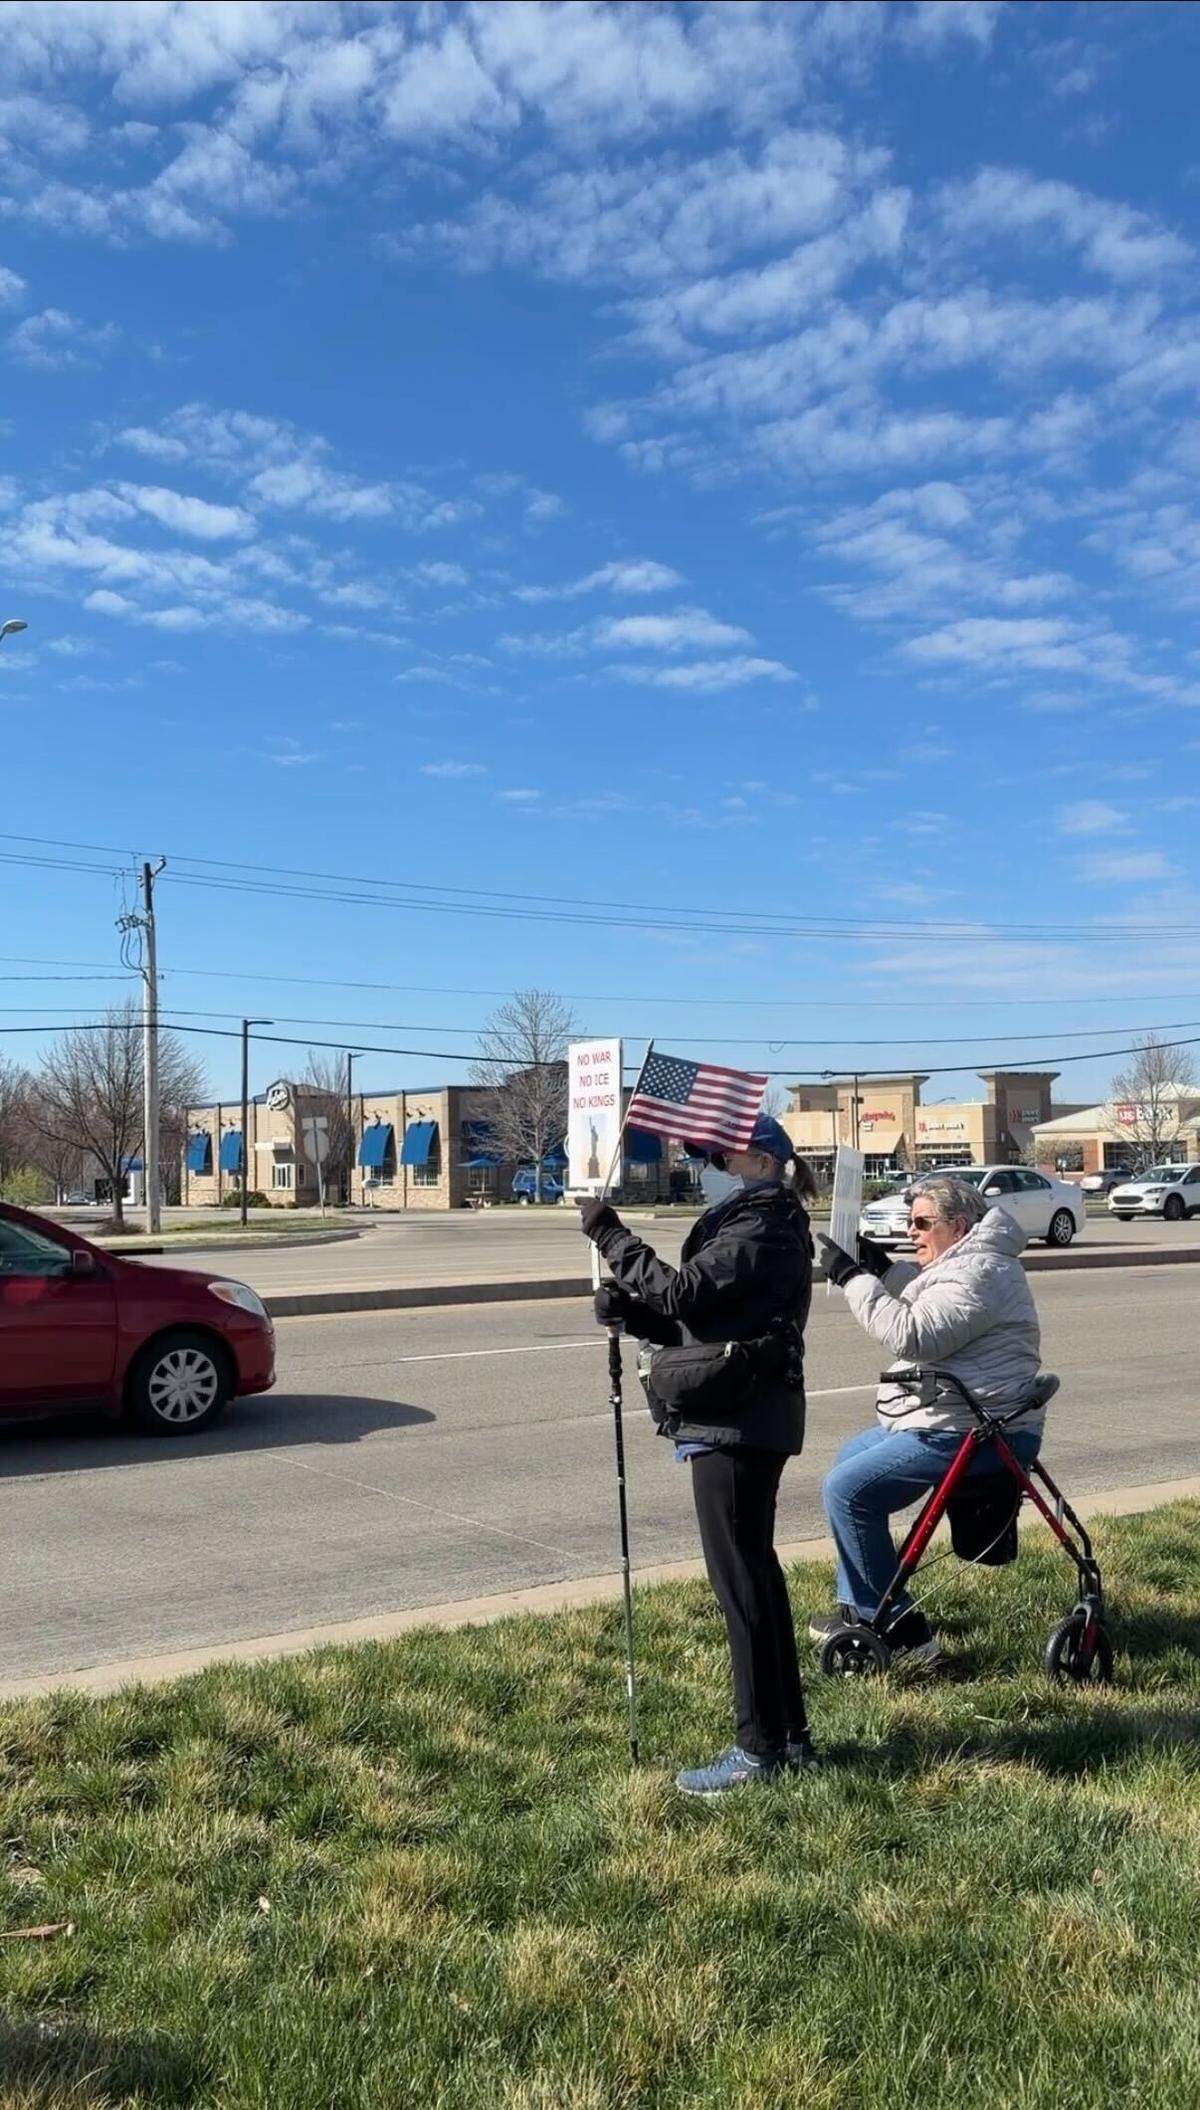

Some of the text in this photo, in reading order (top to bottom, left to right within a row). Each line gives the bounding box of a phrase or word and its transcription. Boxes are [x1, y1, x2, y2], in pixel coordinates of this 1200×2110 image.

[577, 1050, 612, 1066] NO WAR
[579, 1073, 610, 1087] NO ICE
[573, 1094, 616, 1109] NO KINGS
